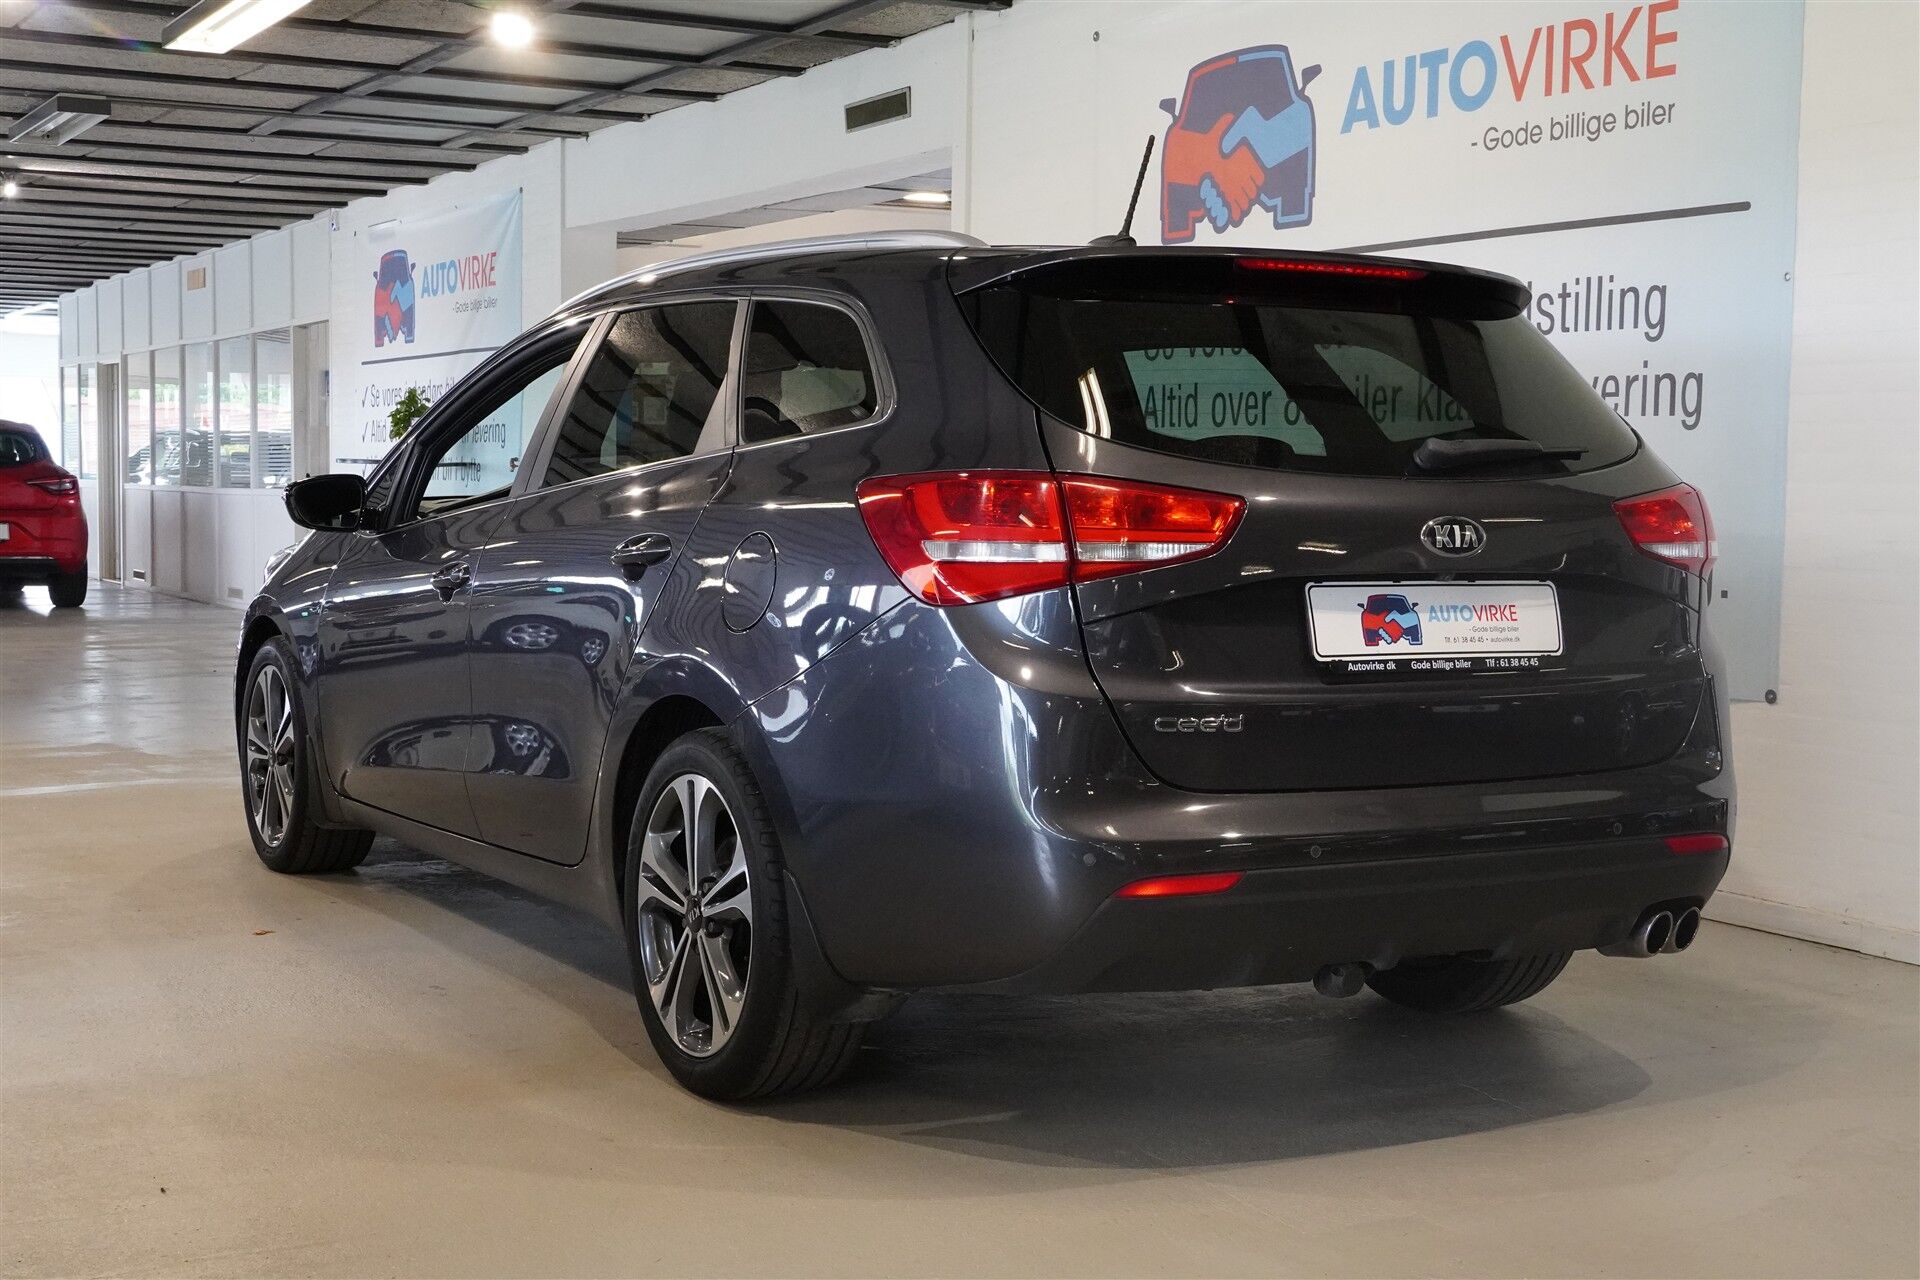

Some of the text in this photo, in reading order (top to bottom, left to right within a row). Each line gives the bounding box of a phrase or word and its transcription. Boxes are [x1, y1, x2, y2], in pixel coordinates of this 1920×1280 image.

[1340, 0, 1680, 135] AUTOVIRKE
[1483, 121, 1543, 151] Gode
[1549, 110, 1617, 142] billige
[1624, 101, 1676, 130] biler
[421, 252, 497, 299] AUTOVIRKE
[370, 384, 380, 407] Se
[1144, 383, 1198, 429] Altid
[1211, 388, 1271, 428] over
[1354, 374, 1403, 423] iler
[1417, 371, 1465, 422] kla
[371, 419, 387, 442] Altid
[1434, 524, 1479, 548] KIA
[1428, 604, 1518, 622] AUTOVIRKE
[1461, 636, 1469, 644] 38
[1469, 636, 1477, 644] 45
[1347, 662, 1385, 671] Autovirke
[1411, 660, 1431, 670] Gode
[1432, 659, 1454, 671] billige
[1454, 659, 1472, 669] biler
[1500, 658, 1510, 667] 61
[1510, 658, 1520, 667] 38
[1520, 657, 1529, 667] 45
[1529, 657, 1539, 666] 45
